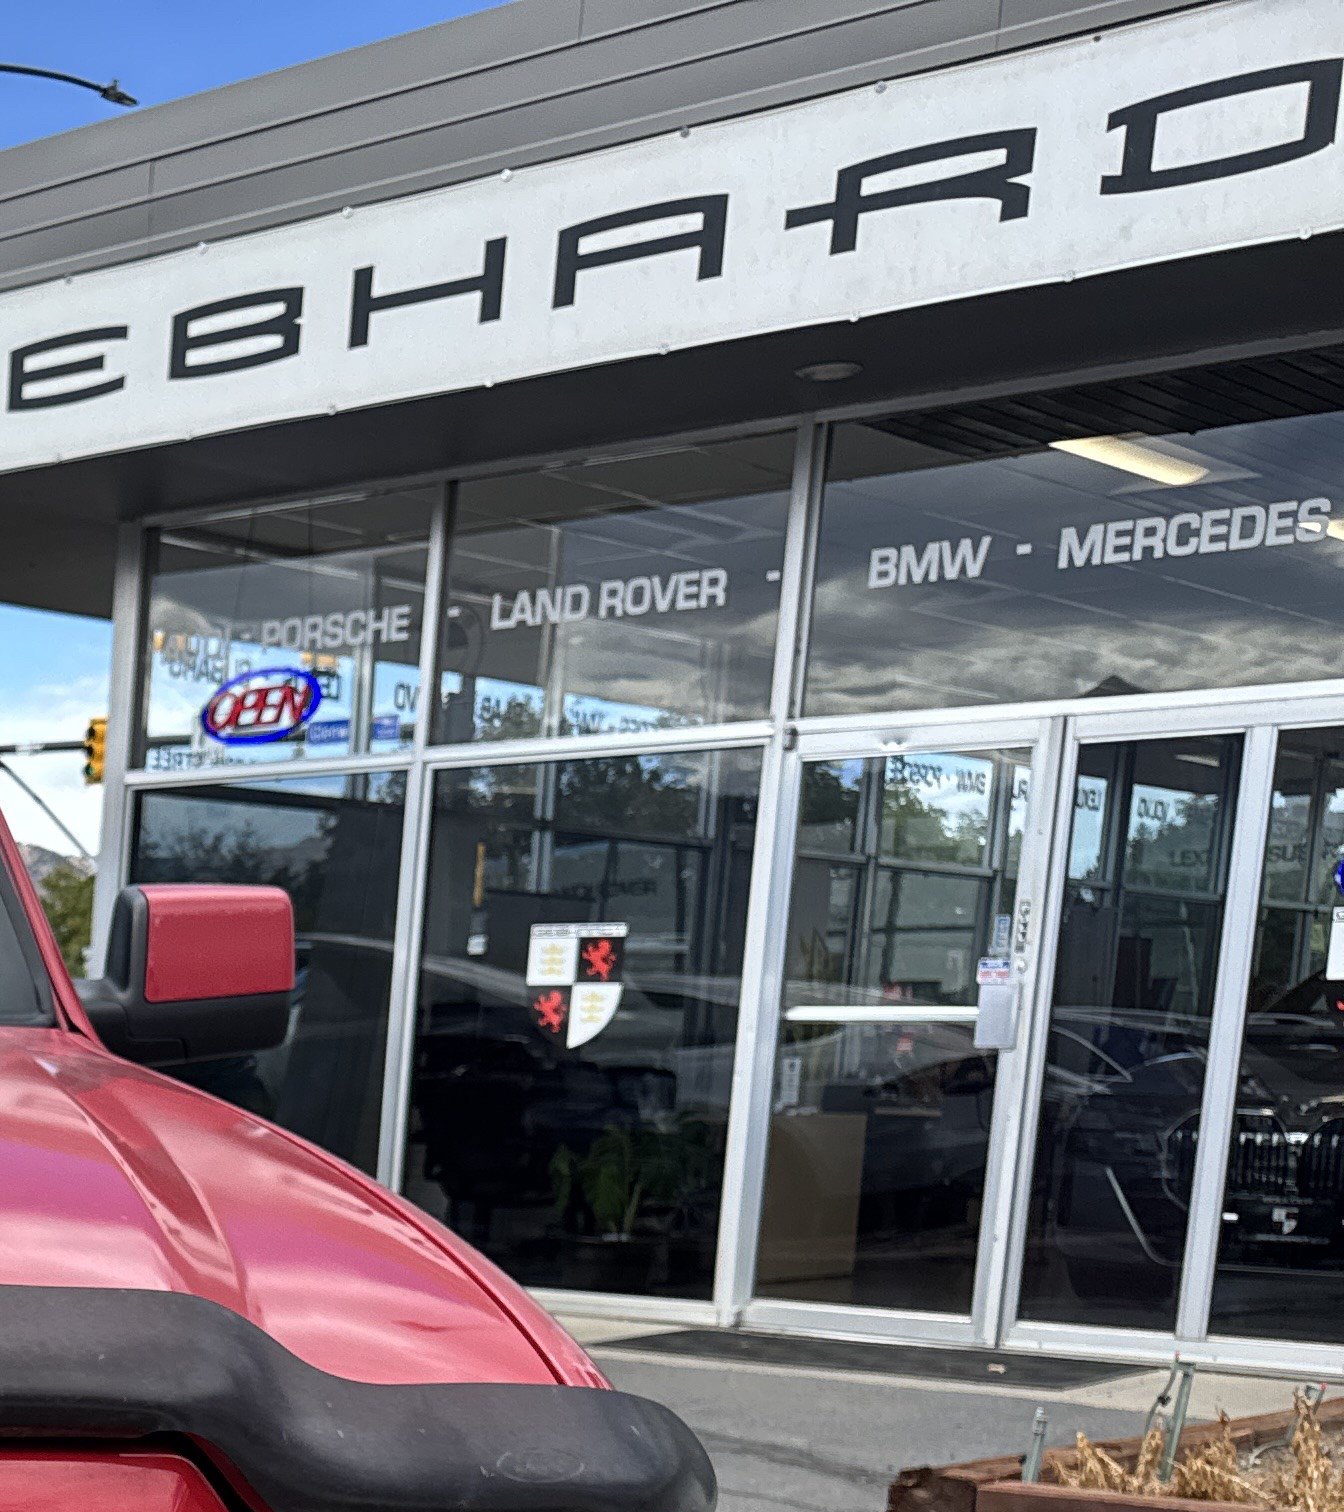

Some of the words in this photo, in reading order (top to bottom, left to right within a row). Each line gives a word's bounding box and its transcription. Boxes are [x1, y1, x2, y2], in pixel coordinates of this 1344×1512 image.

[262, 604, 412, 651] PORSCHE
[489, 583, 592, 631] LAND
[599, 567, 728, 620] ROVER
[868, 535, 991, 588] BMW
[1057, 497, 1332, 570] MERCEDES
[207, 684, 310, 731] OPEN
